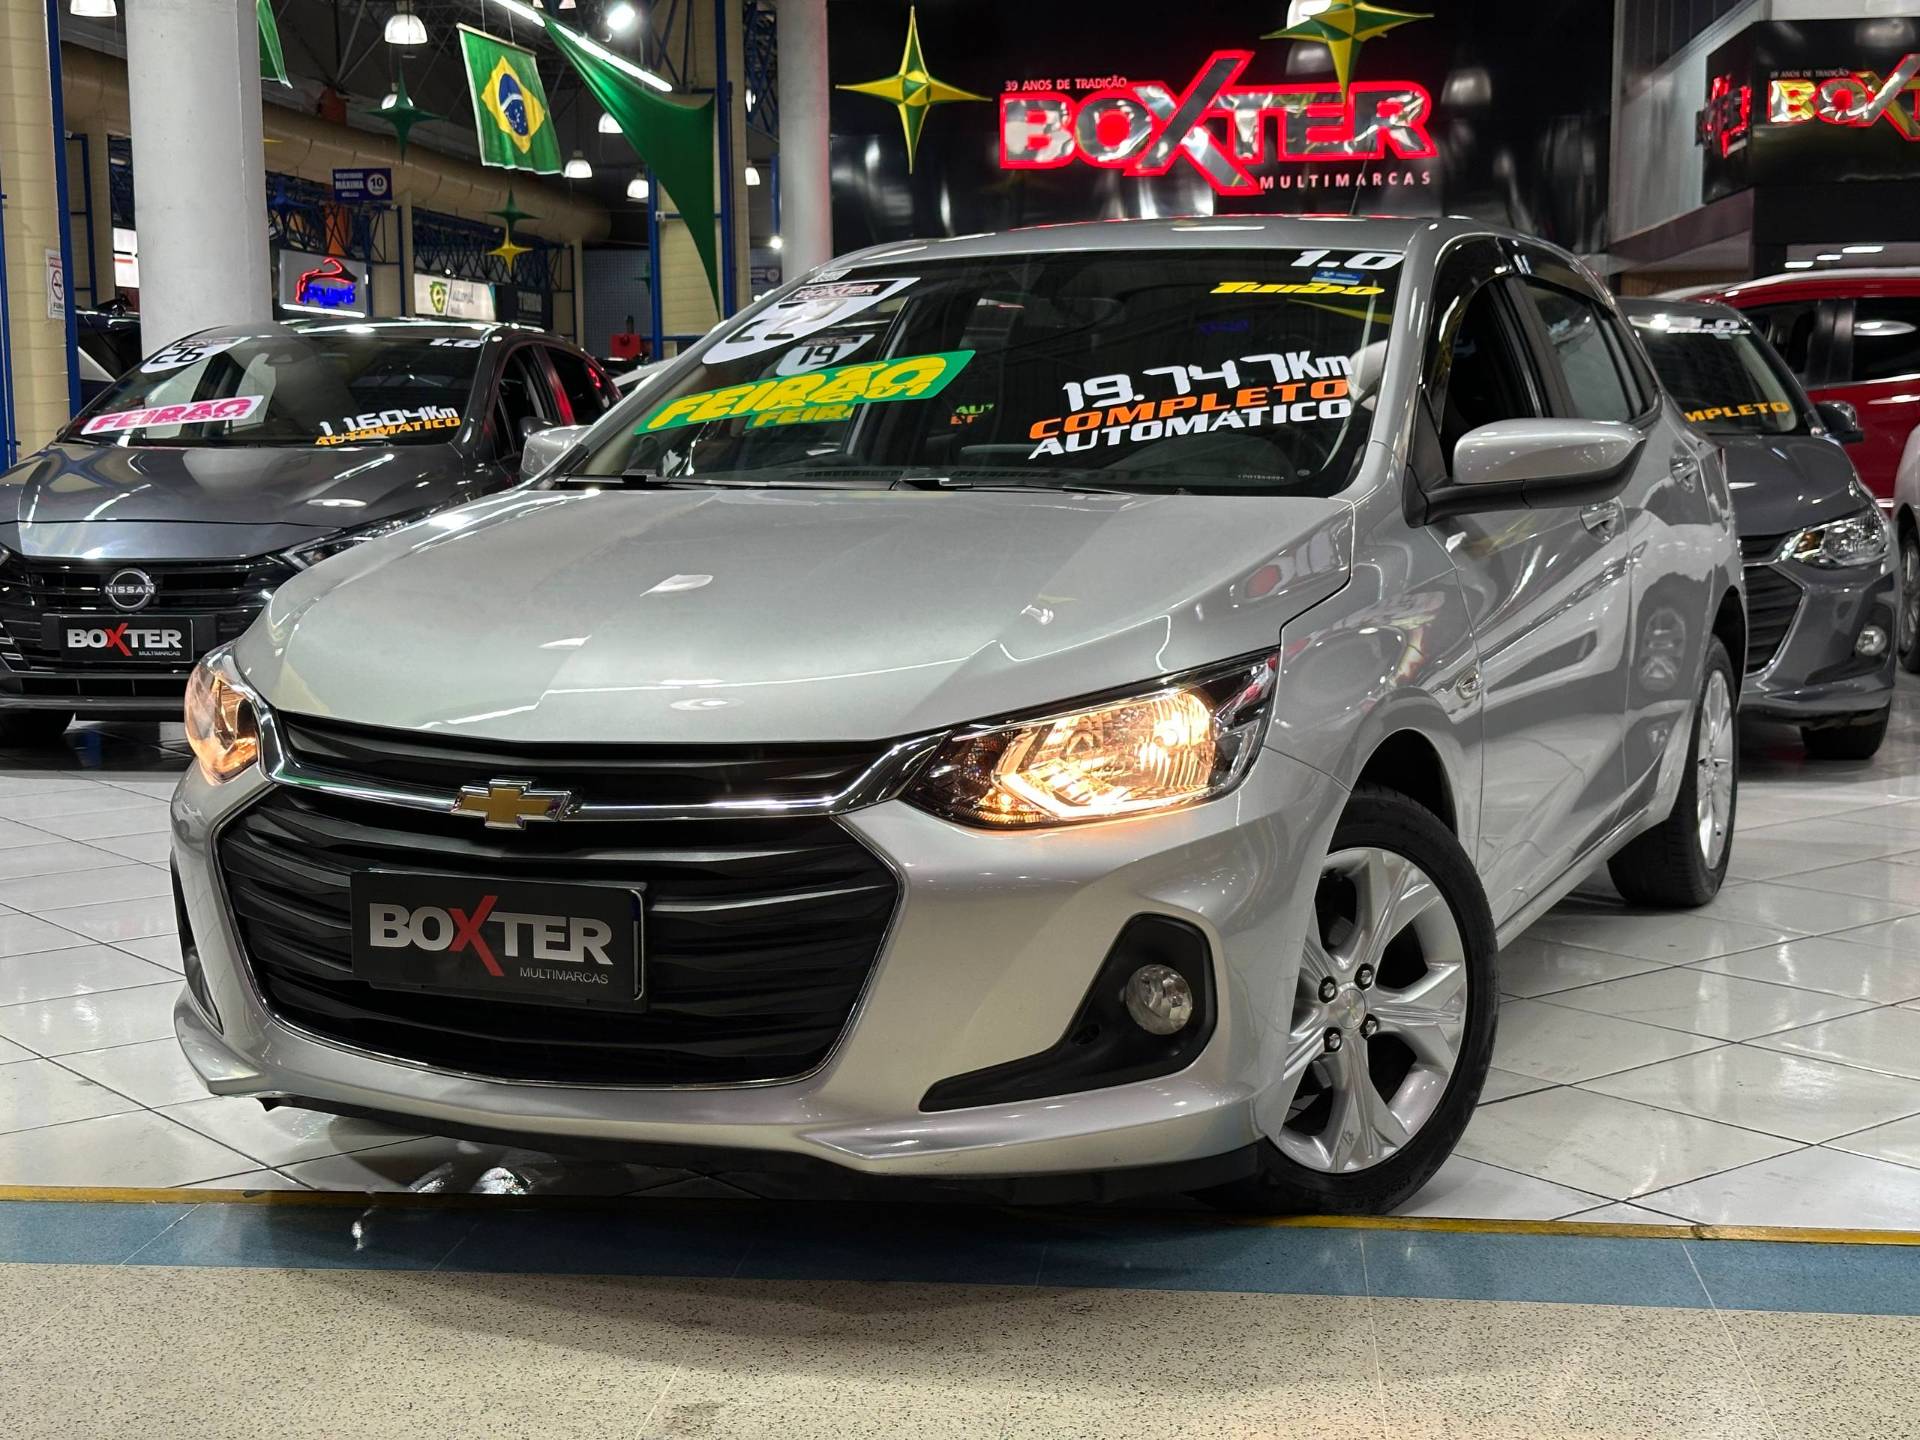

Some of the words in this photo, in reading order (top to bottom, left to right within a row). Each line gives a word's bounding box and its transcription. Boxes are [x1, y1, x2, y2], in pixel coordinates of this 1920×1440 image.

[1005, 80, 1018, 91] 39
[1022, 79, 1052, 91] ANOS
[1056, 78, 1070, 90] DE
[1075, 75, 1127, 89] TRADIÇÃO
[1000, 50, 1438, 195] BOXTER
[370, 177, 385, 188] 10
[1259, 171, 1431, 191] MULTIMARCAS
[1290, 250, 1405, 271] 1.0
[1209, 281, 1385, 296] Turbo
[429, 338, 482, 349] 1.6
[150, 345, 205, 364] 26
[798, 345, 841, 366] 19
[647, 356, 947, 430] FEIRÃO
[91, 398, 252, 432] FEIRÃO
[752, 403, 853, 428] FEIR
[1029, 379, 1350, 440] COMPLETO
[104, 585, 155, 594] NISSAN
[67, 622, 182, 657] BOXTER
[369, 895, 613, 977] BOXTER
[519, 966, 609, 985] MULTIMARCAS
